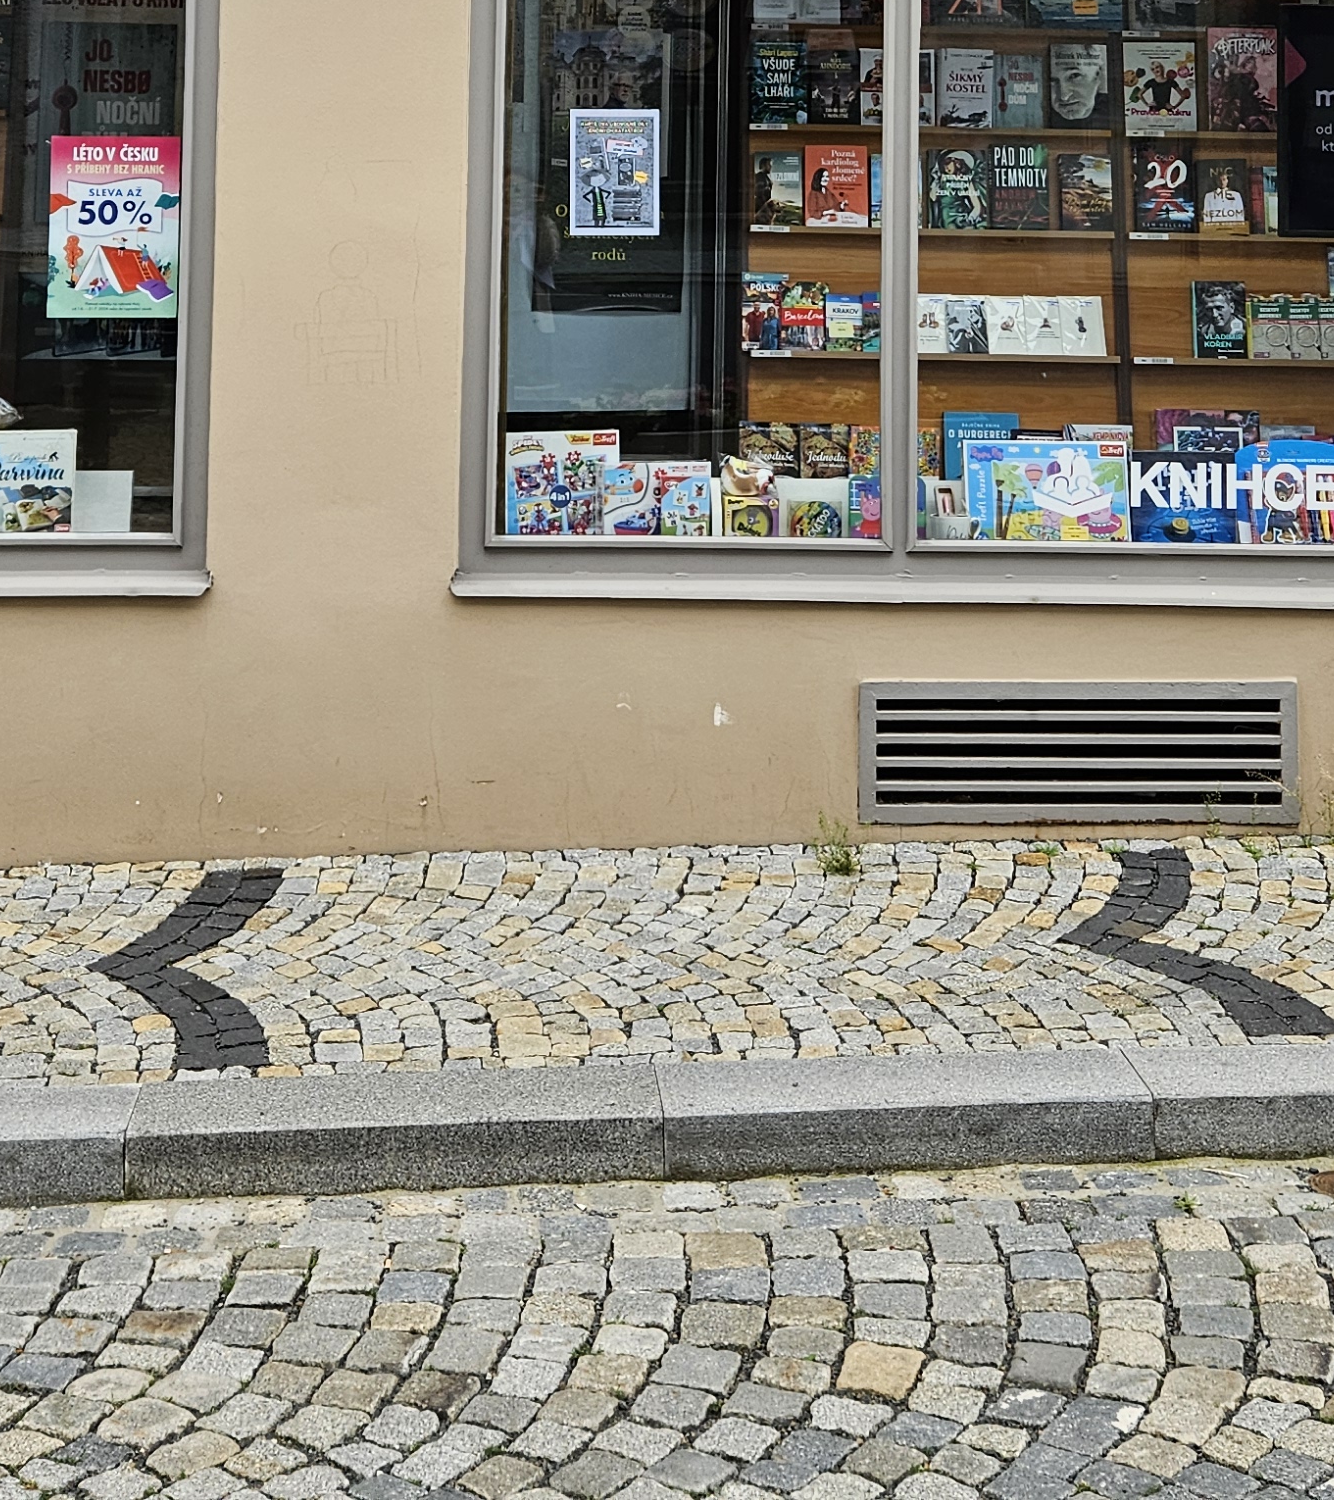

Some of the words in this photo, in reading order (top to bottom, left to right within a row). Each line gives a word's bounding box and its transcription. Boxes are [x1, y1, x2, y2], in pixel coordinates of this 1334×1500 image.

[85, 38, 112, 62] JO
[762, 56, 796, 70] VŠUDE
[83, 69, 151, 94] NESBØ
[767, 71, 792, 84] SAMÍ
[948, 69, 985, 83] ŠIKMÝ
[945, 83, 988, 94] KOSTEL
[96, 96, 162, 125] NOČNÍ
[1316, 124, 1333, 135] od
[72, 143, 103, 161] LÉTO
[106, 147, 116, 161] V
[120, 143, 158, 162] ČESKU
[831, 150, 856, 158] Pozná
[993, 144, 1017, 167] PÁD
[1019, 149, 1035, 167] DO
[114, 164, 128, 174] BEZ
[131, 164, 165, 175] HRANIC
[821, 158, 860, 168] kardiolog
[994, 168, 1048, 188] TEMNOTY
[1143, 159, 1188, 189] 20
[88, 188, 124, 197] SLEVA
[127, 186, 143, 197] AŽ
[591, 248, 627, 261] rodů
[832, 307, 860, 315] KRAKOV
[948, 430, 955, 438] O
